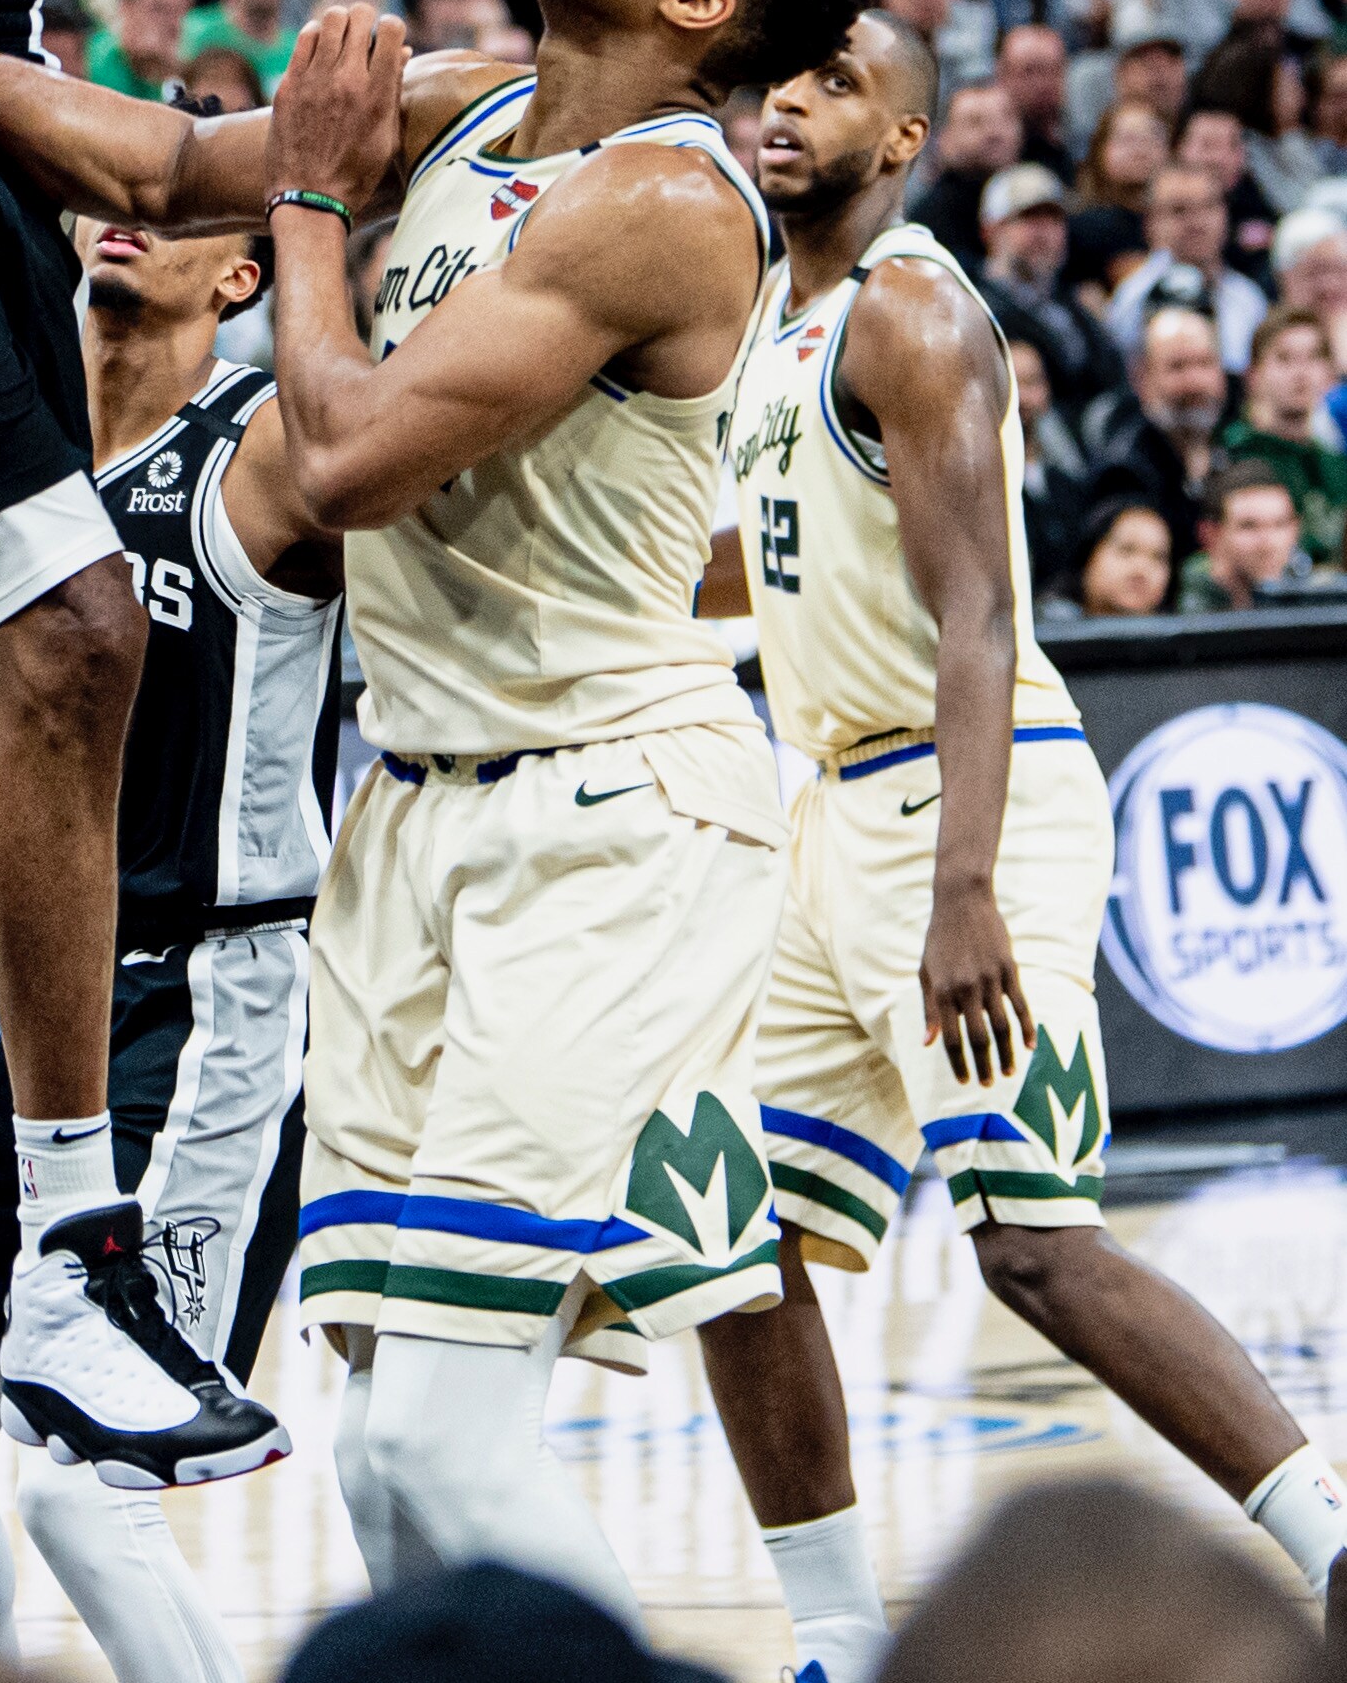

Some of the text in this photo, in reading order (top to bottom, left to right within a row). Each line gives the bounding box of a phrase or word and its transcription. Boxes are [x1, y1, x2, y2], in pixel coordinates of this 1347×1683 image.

[126, 487, 186, 513] Frost
[760, 495, 801, 594] 22
[1160, 780, 1326, 914] FOX
[1171, 918, 1347, 981] SPORTS
